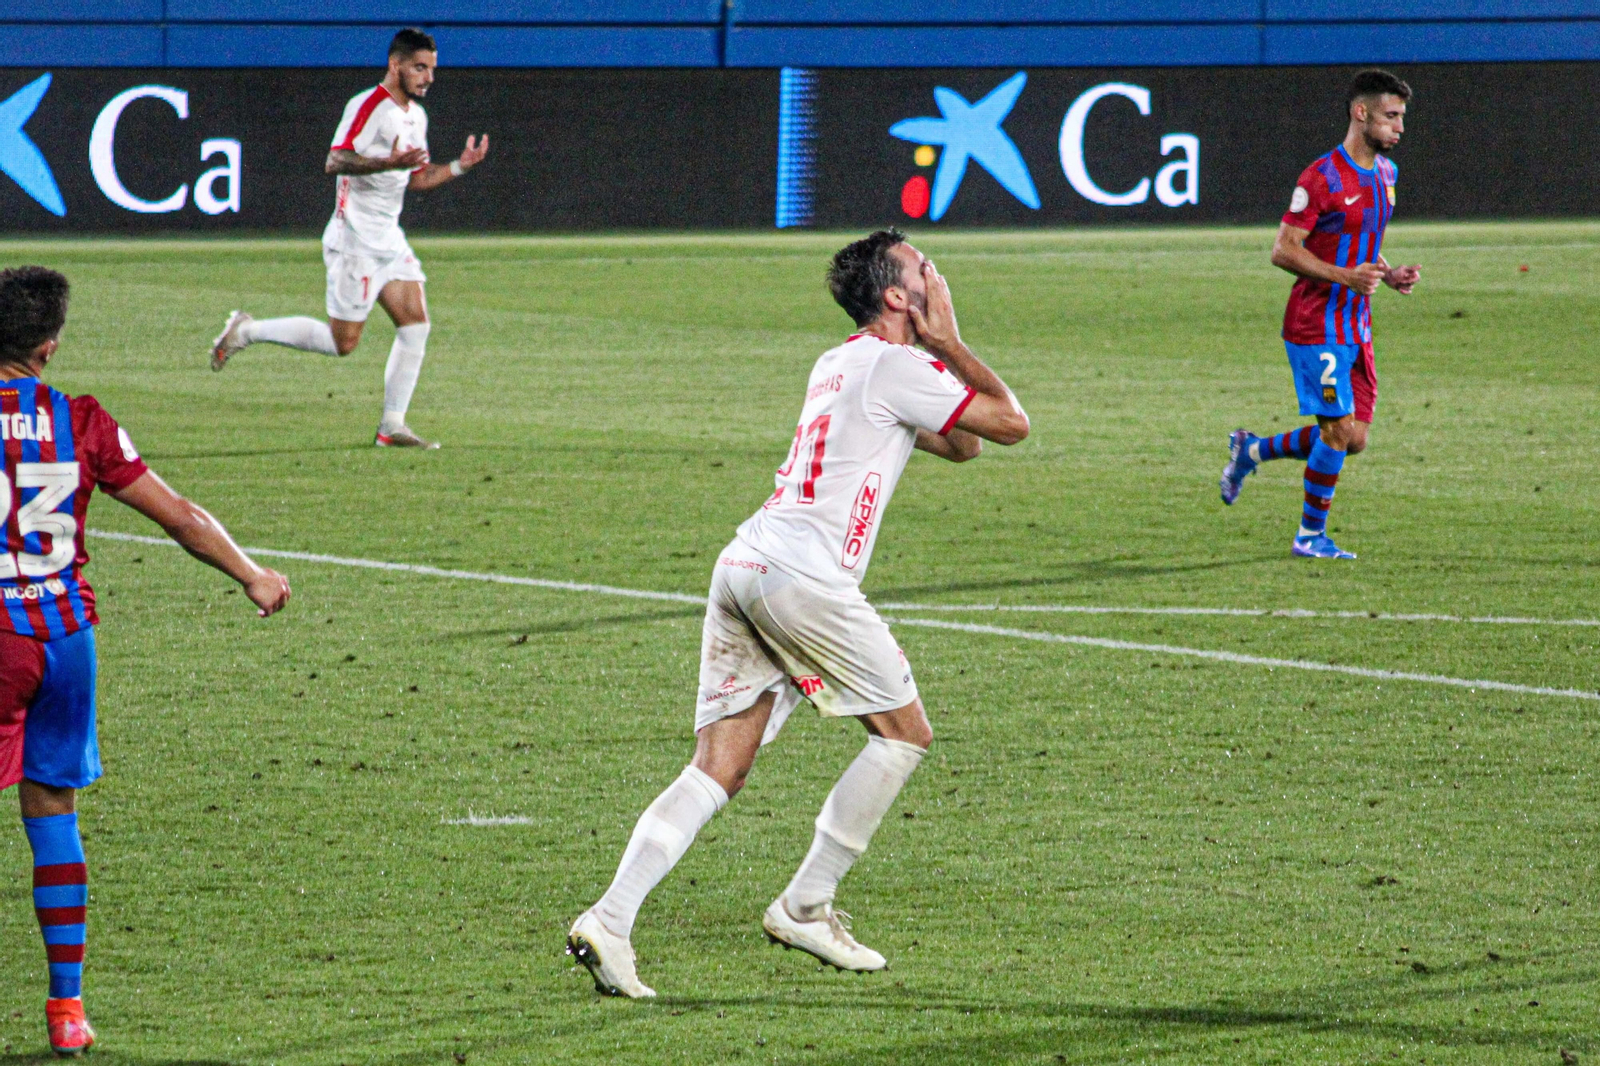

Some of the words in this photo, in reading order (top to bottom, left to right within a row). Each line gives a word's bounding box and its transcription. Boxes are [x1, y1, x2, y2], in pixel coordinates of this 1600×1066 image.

[89, 84, 242, 215] Ca
[1058, 82, 1200, 207] Ca
[1319, 352, 1337, 385] 2
[0, 461, 80, 577] 3
[846, 485, 877, 557] ZPMC
